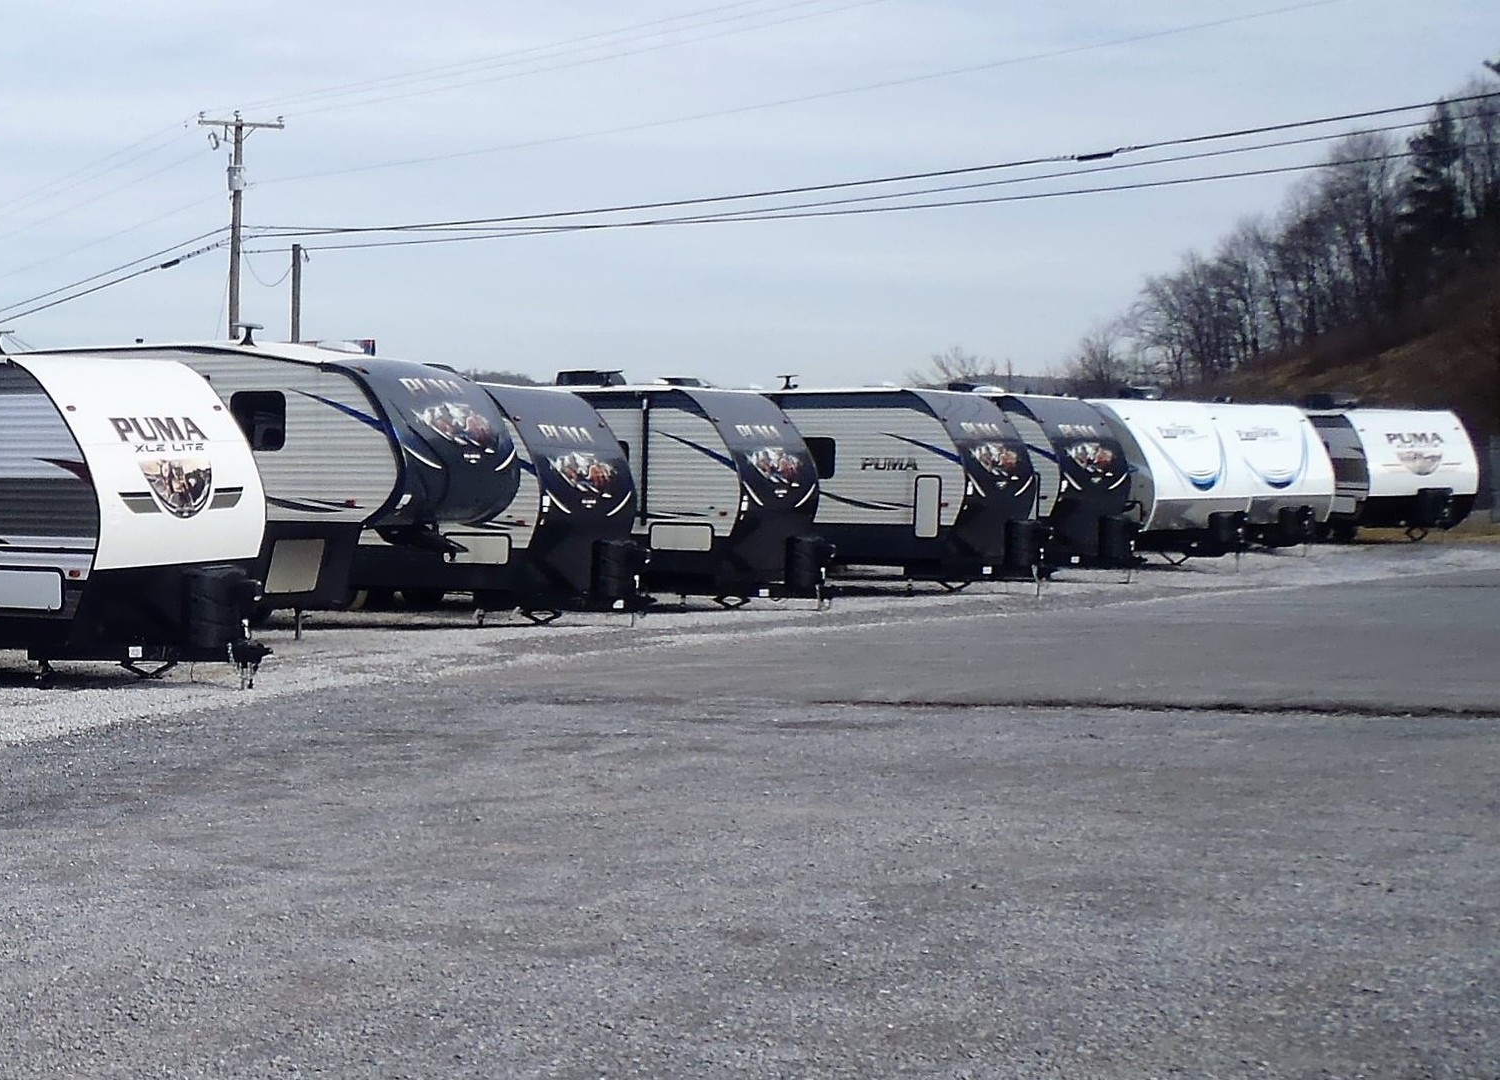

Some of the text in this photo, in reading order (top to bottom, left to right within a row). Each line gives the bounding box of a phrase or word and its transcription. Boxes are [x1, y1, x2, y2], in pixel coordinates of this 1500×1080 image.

[108, 417, 209, 442] PUMA
[1385, 432, 1444, 444] PUMA
[135, 443, 205, 453] XLE LITE
[861, 457, 919, 471] PUMA
